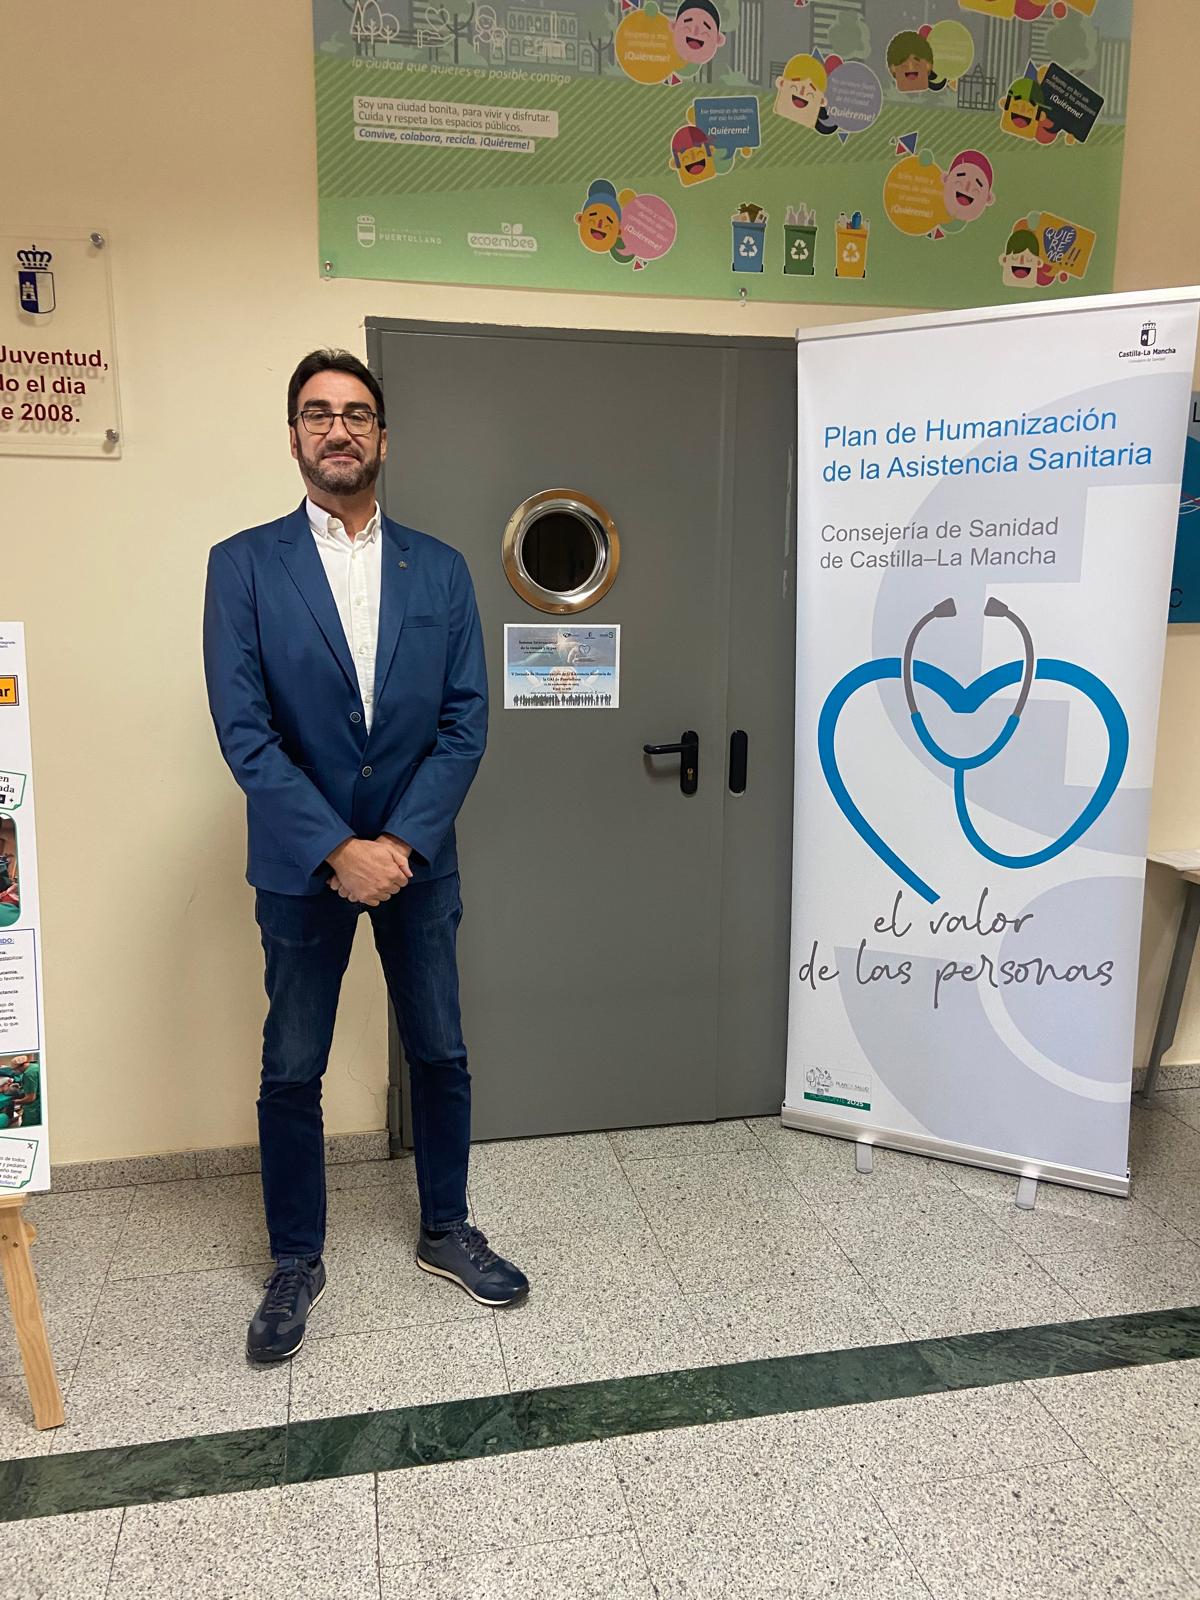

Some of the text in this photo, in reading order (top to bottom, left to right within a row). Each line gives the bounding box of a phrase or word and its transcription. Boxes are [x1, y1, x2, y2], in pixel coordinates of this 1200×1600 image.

[358, 100, 550, 122] Soy una ciudad bonita, para vivir y disfrutar.
[358, 110, 523, 132] Cuida y respeta los espacios públicos.
[359, 128, 530, 150] Convive, colabora, recicla. ¡Quiéreme!
[470, 234, 535, 249] ecoembes
[26, 375, 46, 394] el
[21, 403, 80, 422] 2008.
[824, 408, 1117, 448] Plan de Humanización
[822, 442, 1152, 482] de la Asistencia Sanitaria
[820, 516, 1059, 545] Consejería de Sanidad
[820, 552, 842, 569] de
[970, 546, 1056, 567] Mancha
[873, 887, 1034, 937] el valor
[798, 938, 1114, 1010] de las personas
